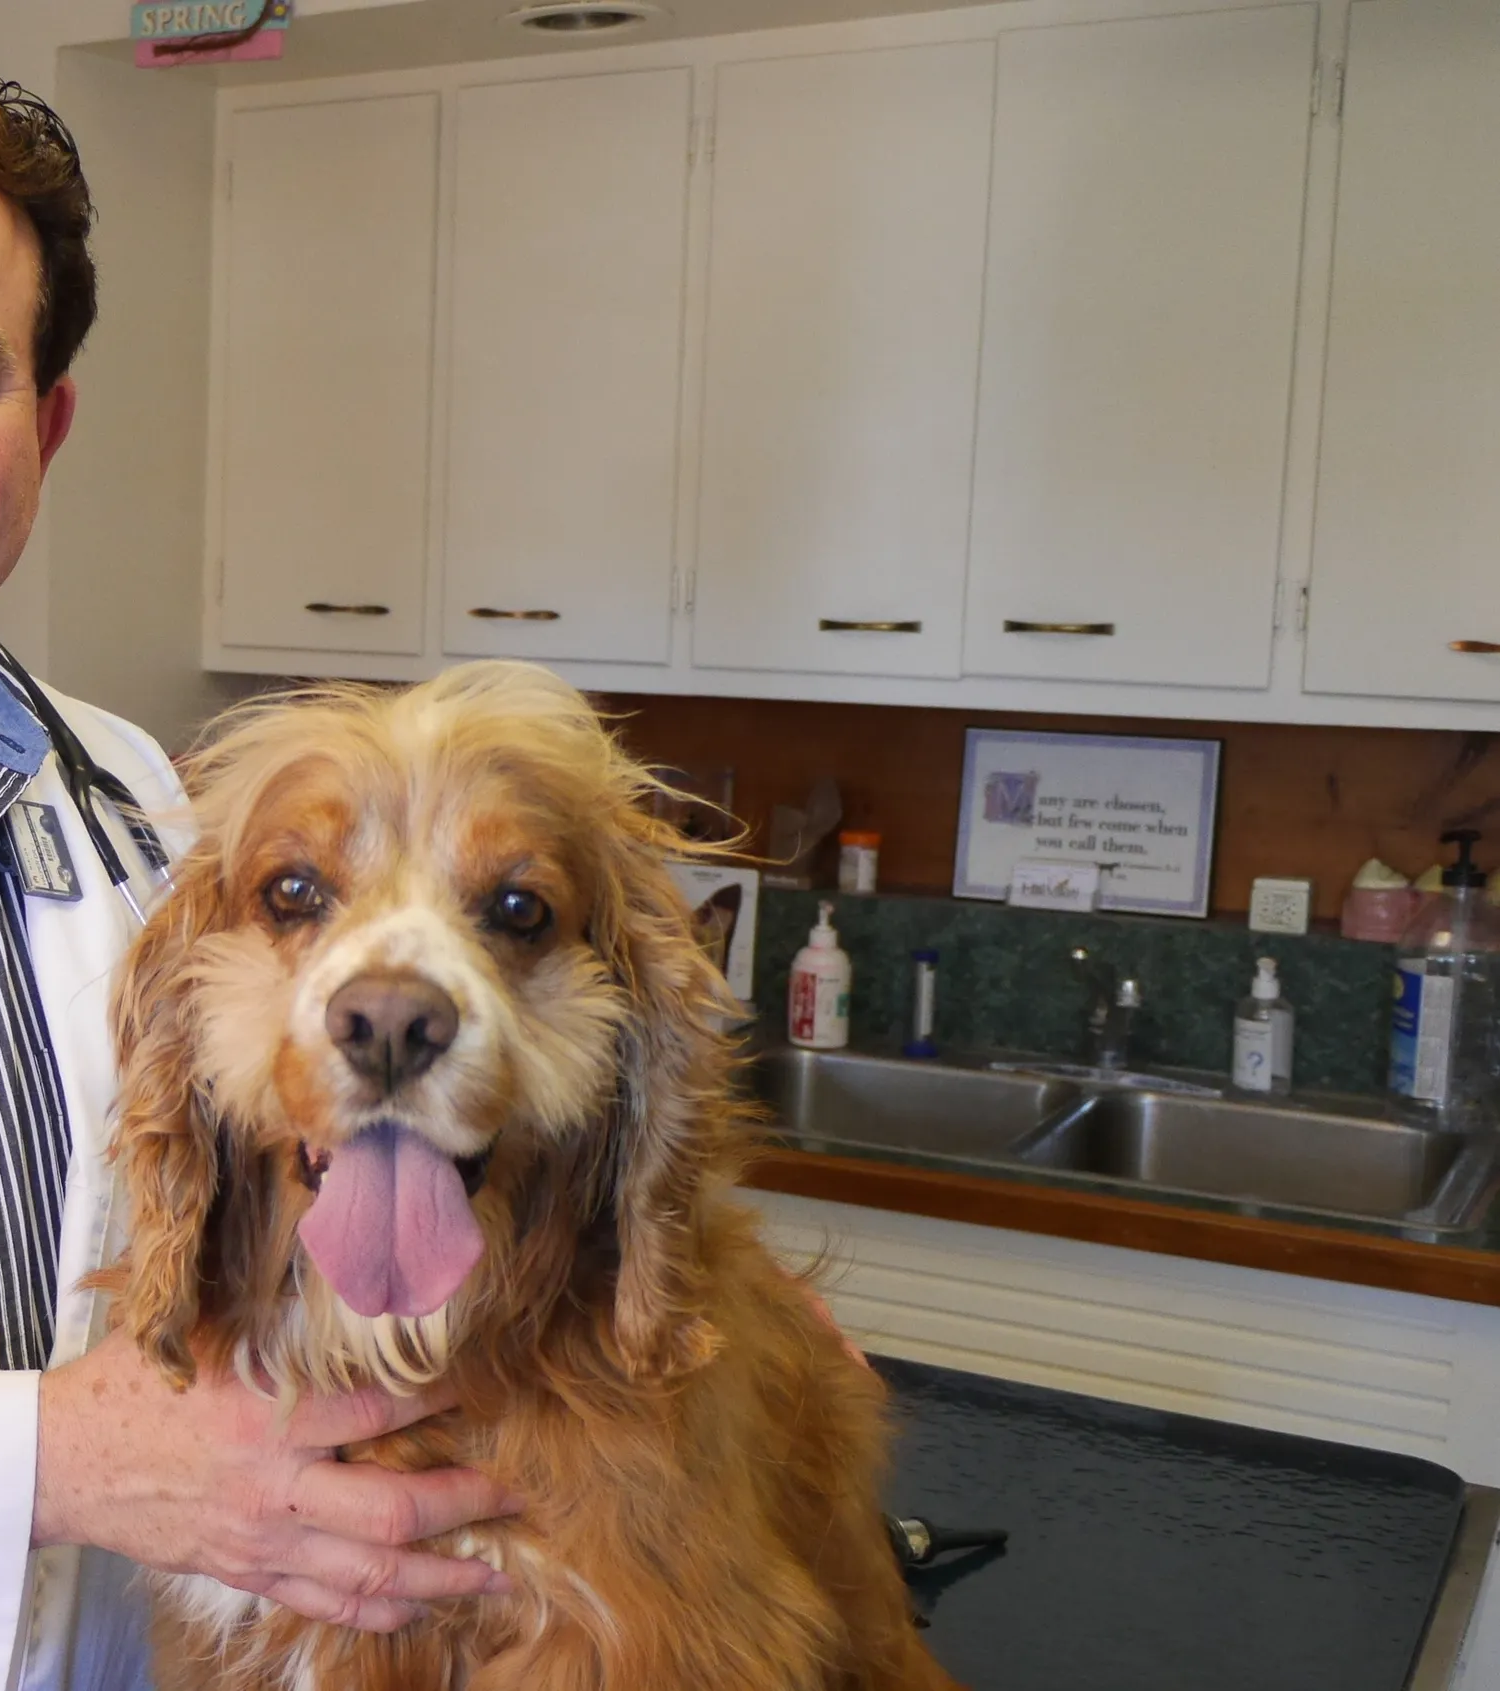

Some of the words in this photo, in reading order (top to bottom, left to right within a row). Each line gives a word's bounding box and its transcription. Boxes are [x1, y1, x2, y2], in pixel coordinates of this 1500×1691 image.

[141, 2, 248, 36] SPRING
[1071, 798, 1100, 809] are
[1104, 793, 1166, 814] chosen,
[1037, 811, 1063, 828] but
[1068, 813, 1092, 829] few
[1099, 820, 1141, 833] come
[1144, 819, 1189, 837] when
[1035, 836, 1063, 851] you
[1068, 835, 1097, 851] call
[1102, 837, 1148, 855] them.
